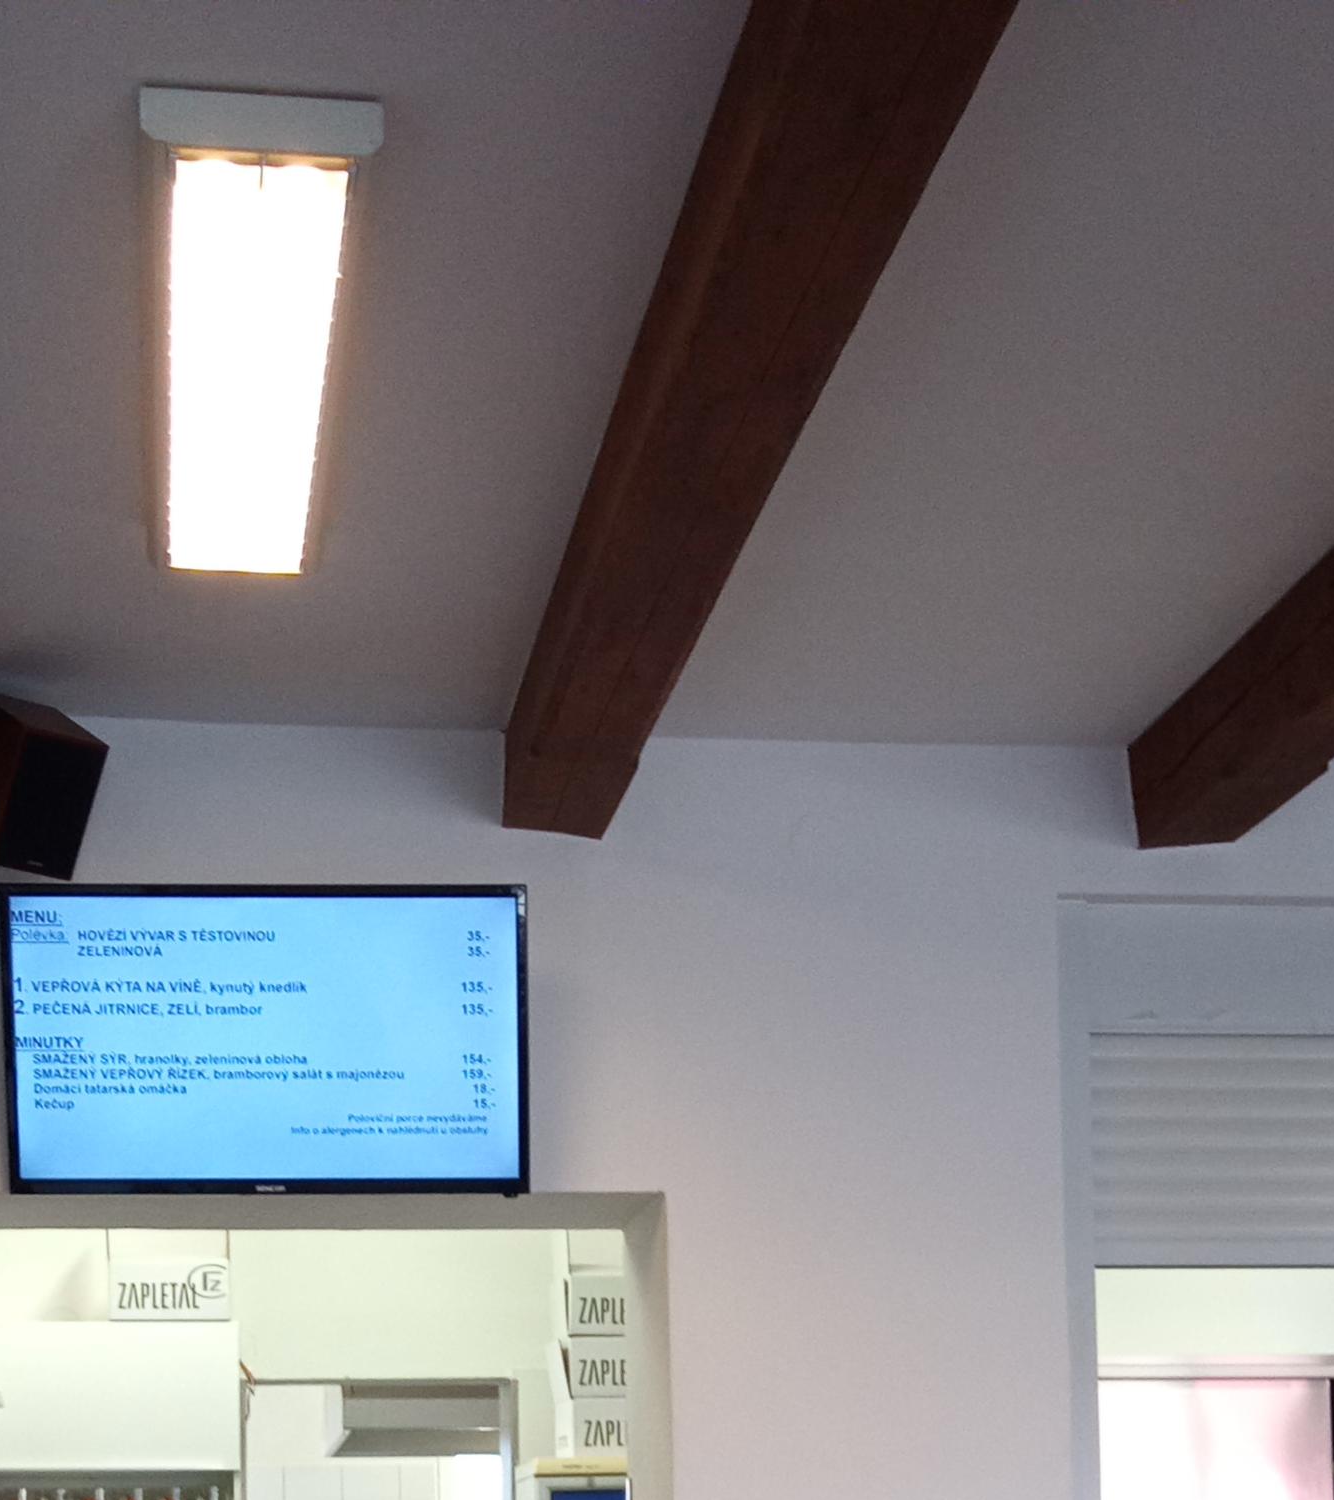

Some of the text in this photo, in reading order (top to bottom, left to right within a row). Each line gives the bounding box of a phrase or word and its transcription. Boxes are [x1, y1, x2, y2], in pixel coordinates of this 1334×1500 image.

[77, 928, 127, 941] HOVĚZÍ
[130, 928, 175, 941] VÝVAR
[178, 930, 187, 941] S
[191, 928, 276, 941] TĚSTOVINOU
[77, 944, 163, 957] ZELENINOVÁ
[31, 978, 101, 992] VEPŘOVÁ
[105, 979, 142, 992] KÝTA
[146, 981, 166, 992] NA
[169, 978, 207, 994] VÍNĚ,
[209, 981, 255, 995] kynutý
[32, 1000, 92, 1015] PEČENÁ
[94, 1003, 164, 1017] JITRNICE,
[15, 1036, 84, 1050] MINUTKY
[33, 1050, 96, 1065] SMAŽENÝ
[265, 1054, 307, 1065] obloha
[33, 1066, 97, 1080] SMAŽENÝ
[100, 1066, 163, 1080] VEPŘOVÝ
[325, 1070, 333, 1079] s
[34, 1098, 75, 1111] Kečup
[118, 1282, 200, 1310] ZAPLETAL
